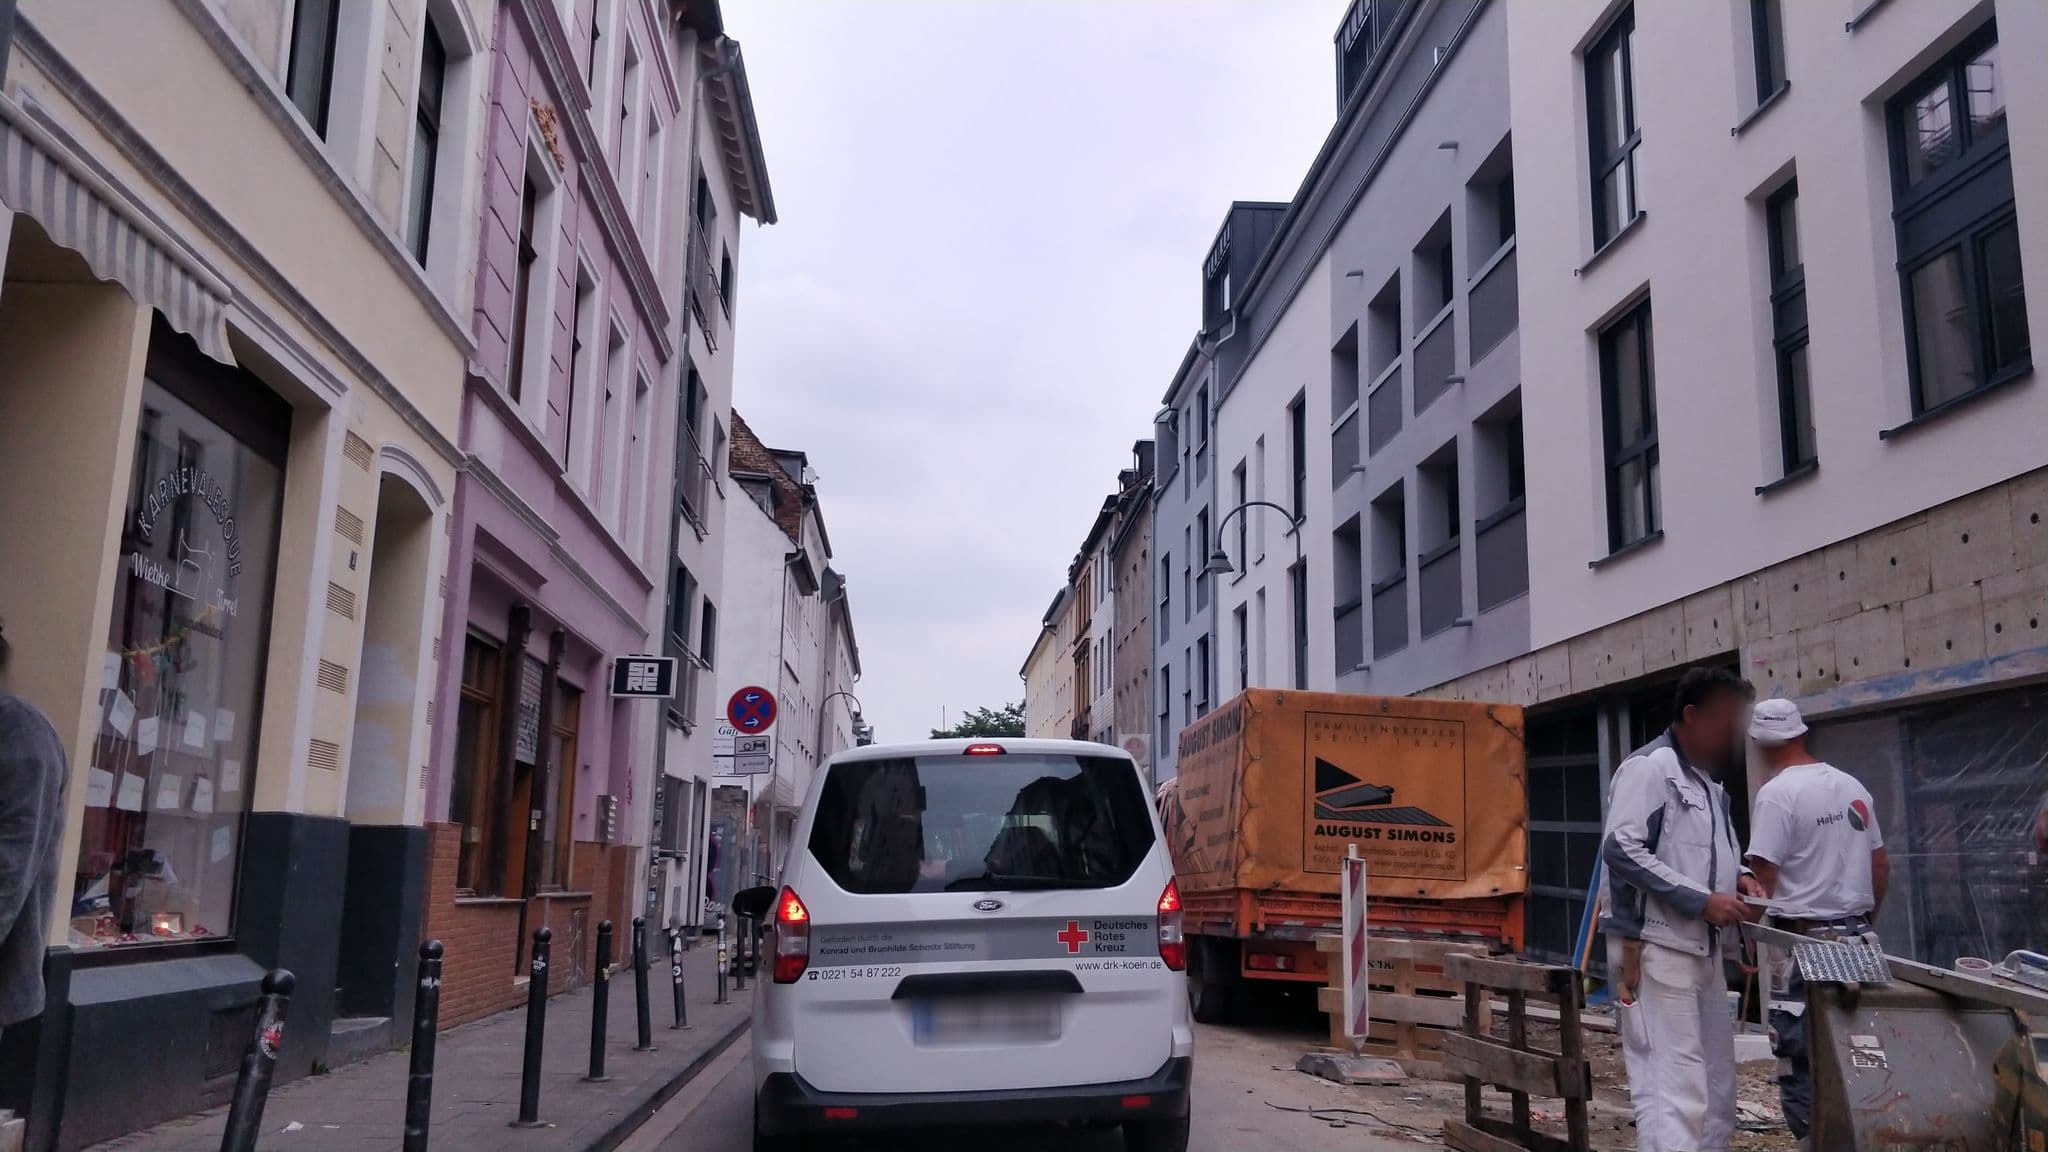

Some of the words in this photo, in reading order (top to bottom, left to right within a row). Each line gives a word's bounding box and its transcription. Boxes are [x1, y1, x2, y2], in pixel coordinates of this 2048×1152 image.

[138, 467, 241, 577] KARNEVALESQUE
[131, 551, 171, 588] Wiebke
[1181, 723, 1210, 757] AUGUST
[1314, 824, 1382, 840] AUGUST
[1387, 828, 1456, 844] SIMONS
[1094, 920, 1148, 930] Deutsches
[1095, 932, 1125, 941] Rotes
[820, 946, 849, 955] Konrad
[851, 945, 866, 954] und
[869, 944, 907, 953] Brunhilde
[909, 943, 942, 952] Schmitz
[944, 942, 976, 952] Stiftung
[1095, 943, 1126, 952] Kreuz
[1075, 959, 1162, 970] www.drk-koeln.de
[822, 969, 847, 980] 0221
[851, 968, 863, 979] 54
[867, 967, 880, 978] 87
[881, 966, 901, 977] 222
